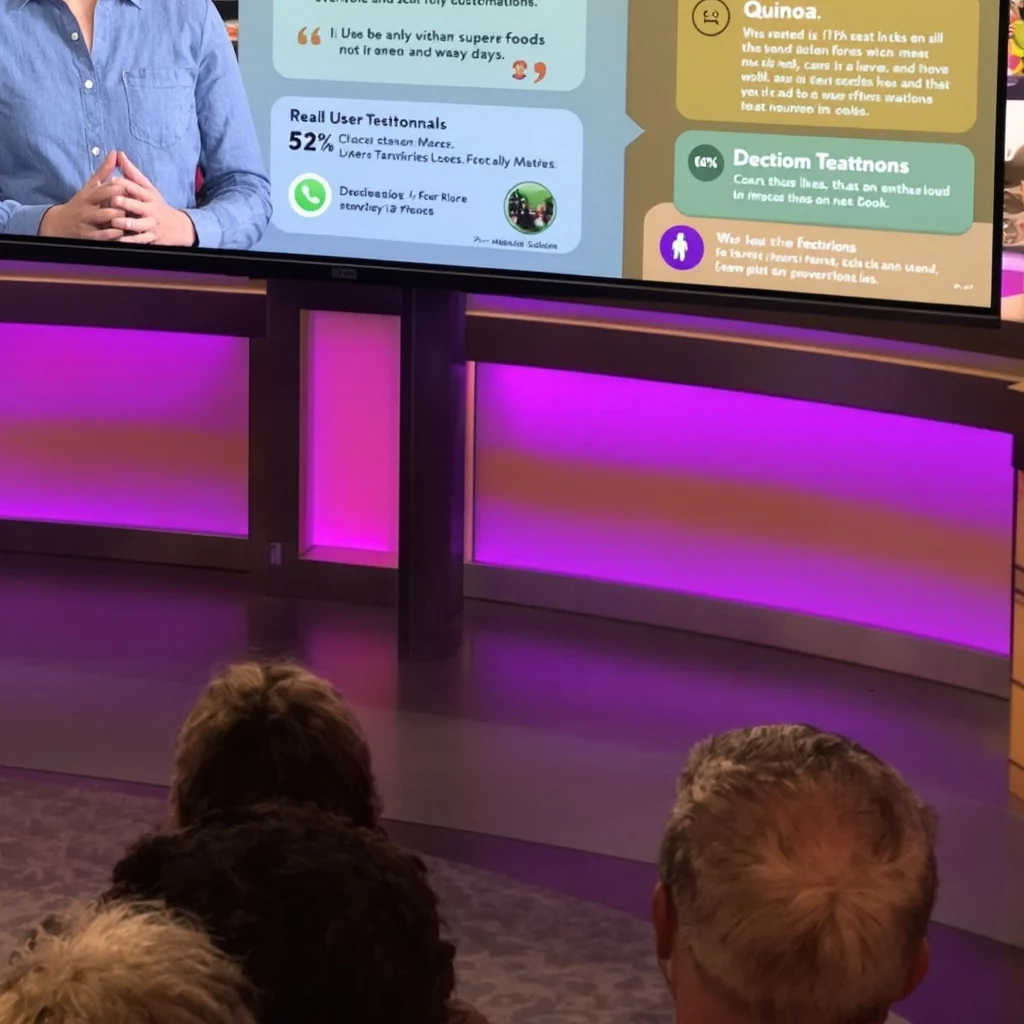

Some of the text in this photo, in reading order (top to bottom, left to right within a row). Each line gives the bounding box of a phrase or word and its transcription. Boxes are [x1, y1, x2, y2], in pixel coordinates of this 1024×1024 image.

[743, 0, 822, 20] Quinoa.
[505, 32, 546, 46] foods
[409, 46, 432, 58] and
[471, 48, 505, 63] days.
[290, 109, 325, 123] Reall
[329, 111, 363, 125] User
[288, 131, 334, 152] 52%
